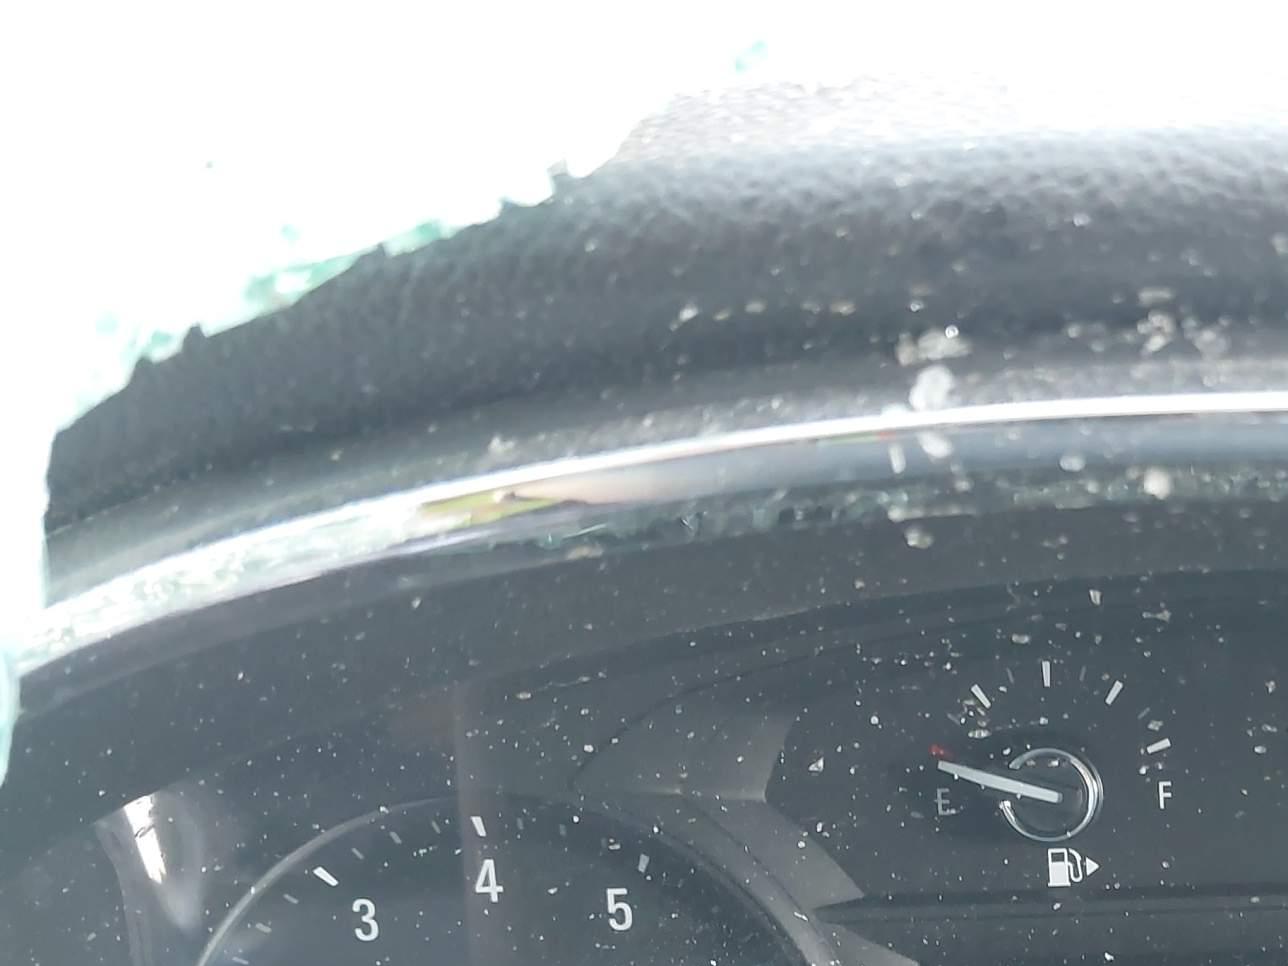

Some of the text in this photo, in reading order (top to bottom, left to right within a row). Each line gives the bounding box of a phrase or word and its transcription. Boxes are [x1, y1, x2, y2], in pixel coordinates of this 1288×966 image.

[935, 788, 952, 816] E
[1158, 781, 1172, 810] F
[475, 859, 503, 902] 4
[354, 899, 379, 942] 3
[606, 888, 633, 931] 5
